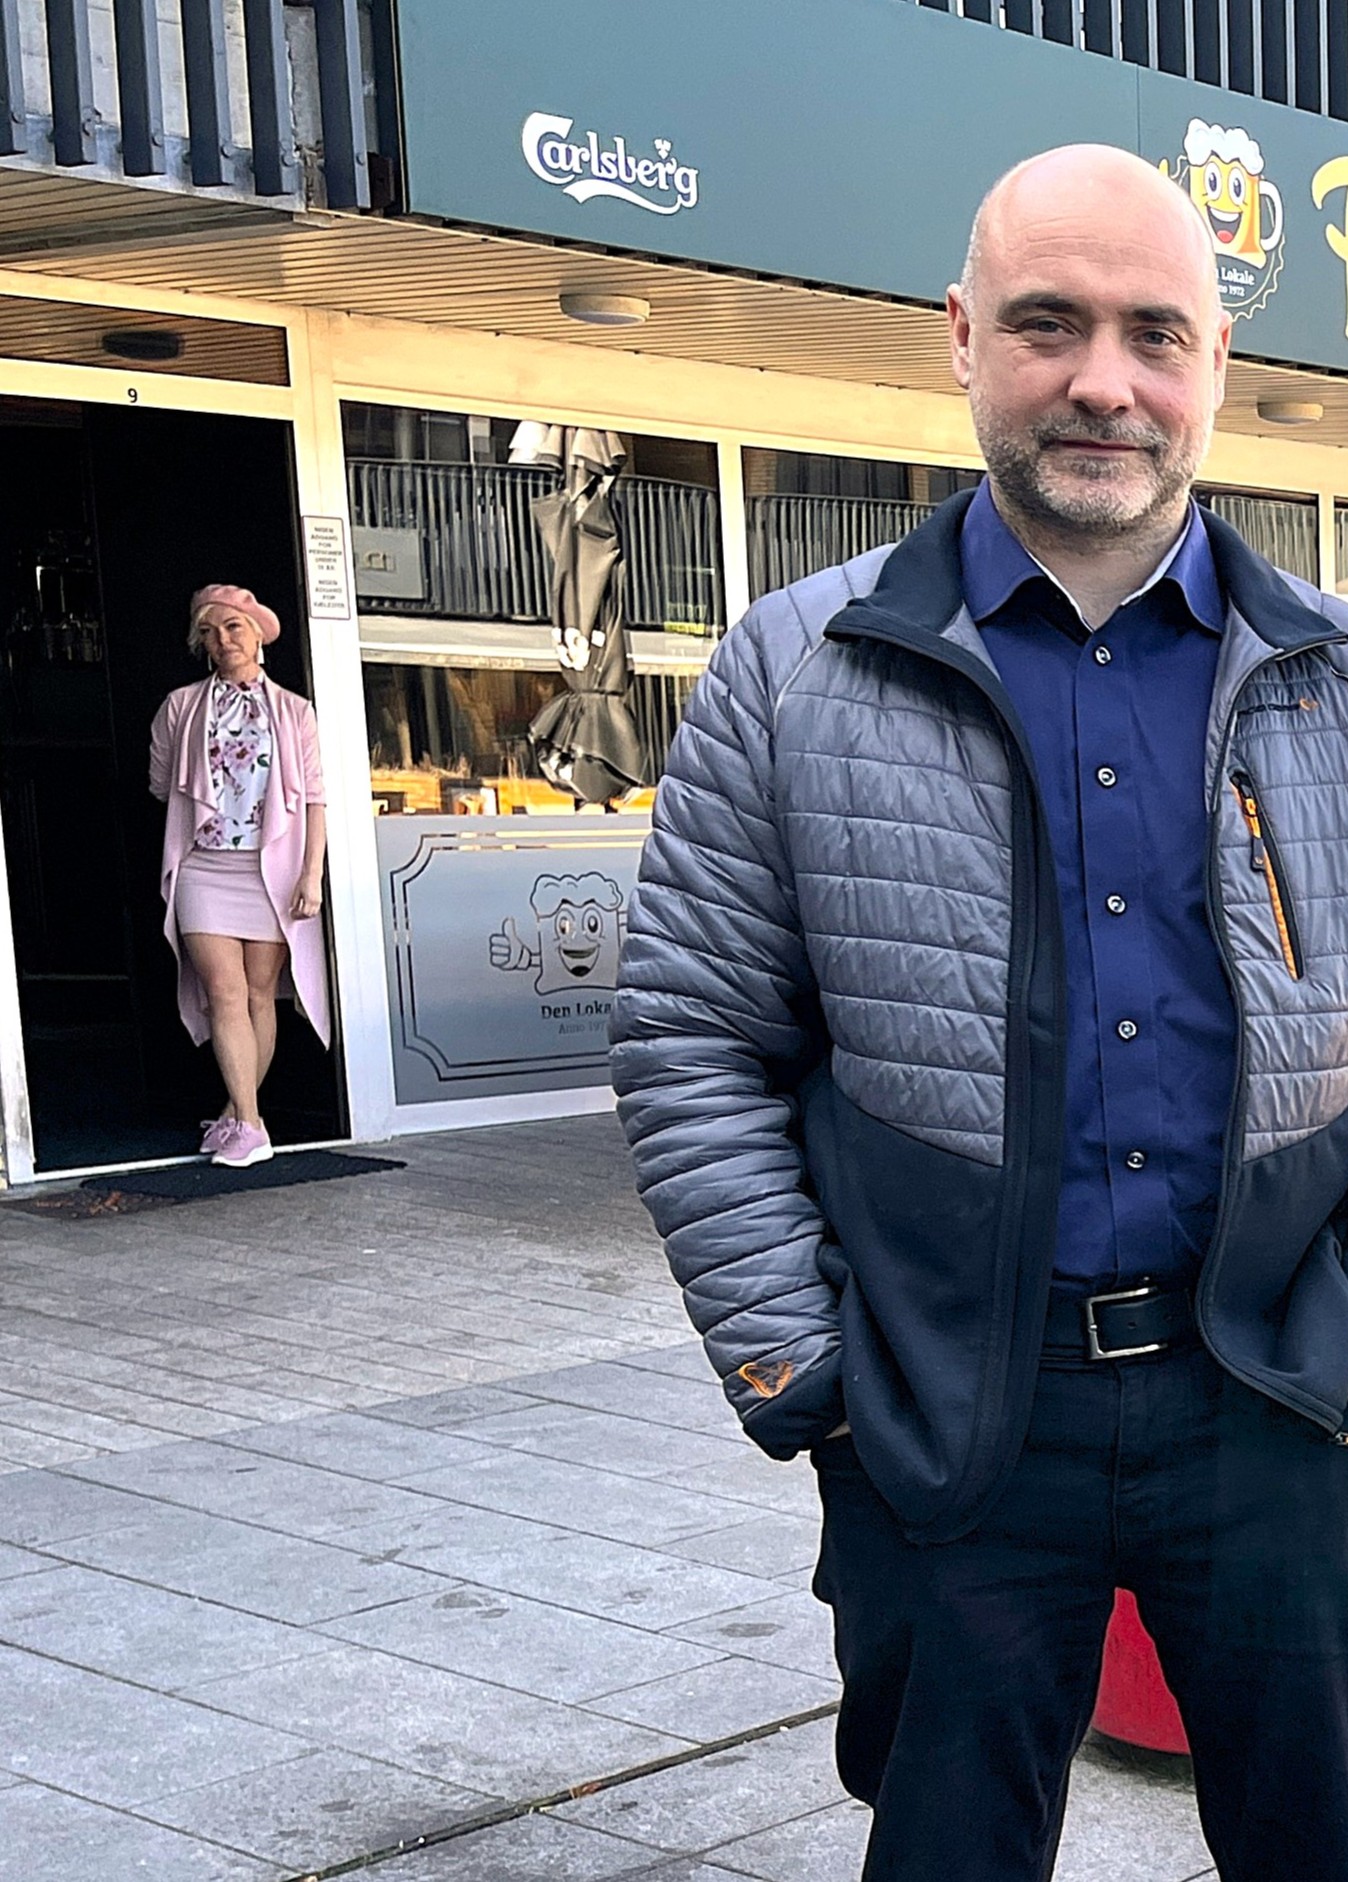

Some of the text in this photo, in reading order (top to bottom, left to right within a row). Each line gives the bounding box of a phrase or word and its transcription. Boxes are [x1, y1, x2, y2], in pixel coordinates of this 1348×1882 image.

[522, 111, 699, 215] Carlsberg
[1221, 266, 1255, 286] Lokale
[127, 387, 138, 404] 9
[541, 1000, 612, 1019] Den Loka
[558, 1020, 606, 1034] Anno 197
